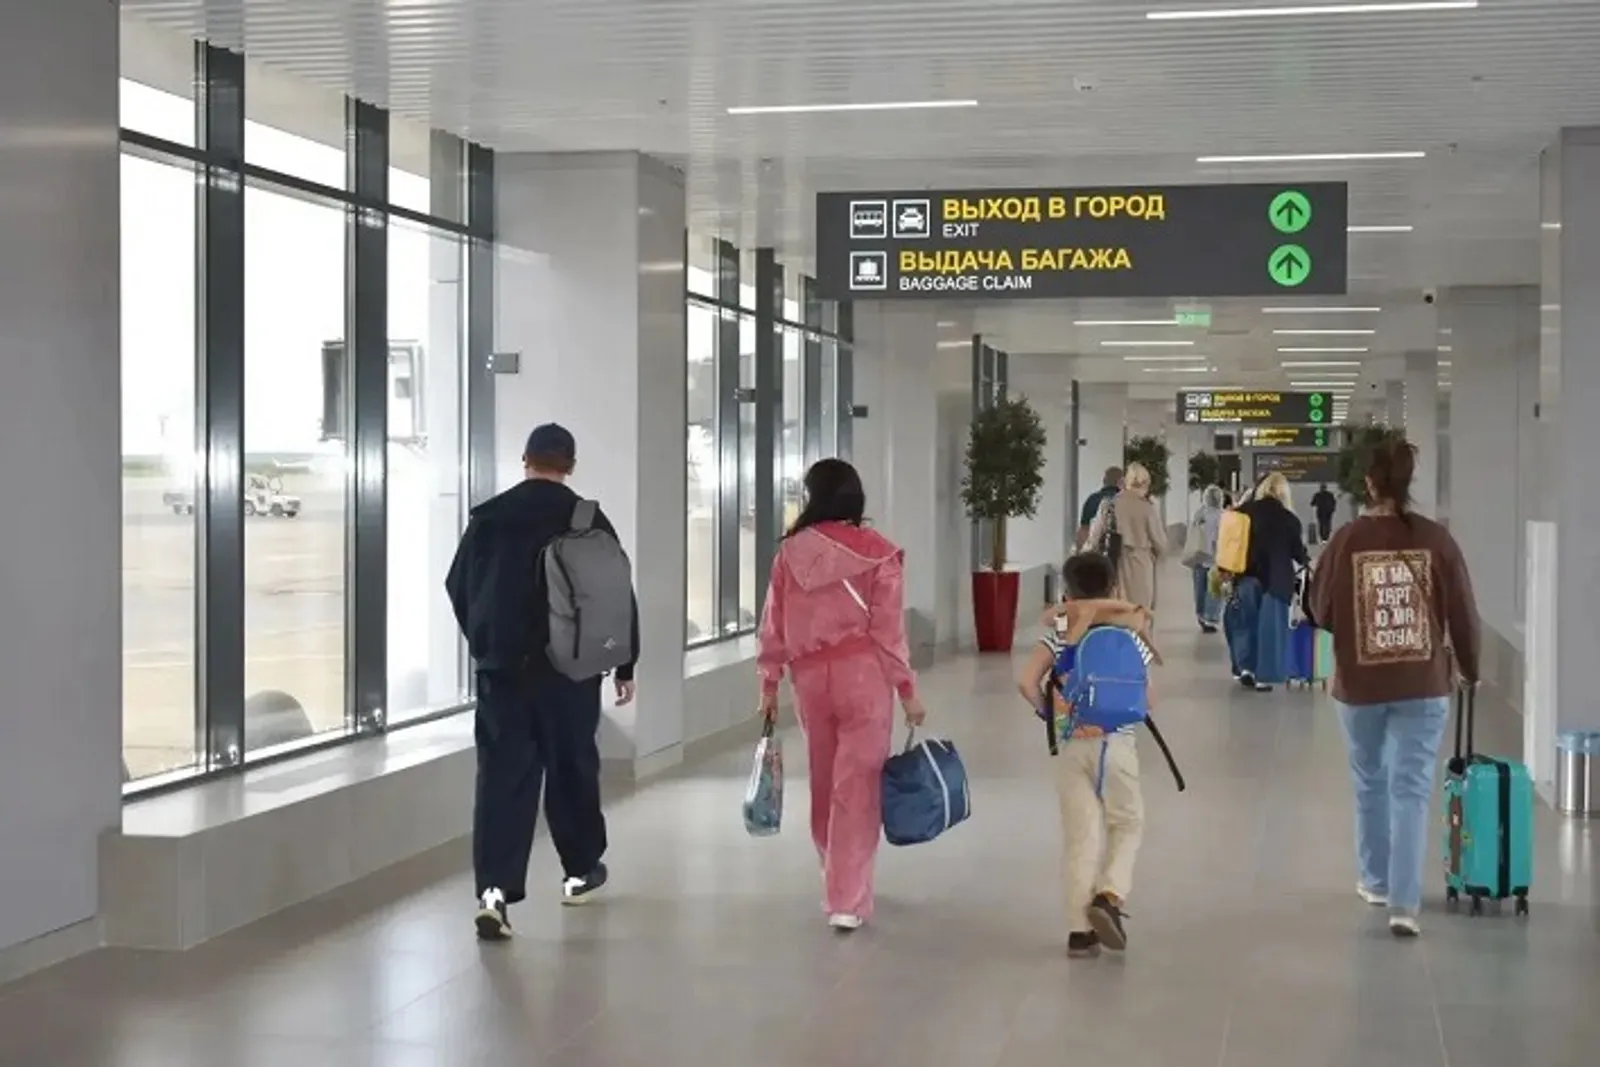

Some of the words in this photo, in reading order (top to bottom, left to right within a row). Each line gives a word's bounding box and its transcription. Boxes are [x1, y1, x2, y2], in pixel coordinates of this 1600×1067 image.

[943, 197, 1040, 222] ВЫХОД
[1049, 197, 1066, 219] В
[1075, 195, 1165, 220] ГОРОД
[943, 223, 980, 237] EXIT
[900, 250, 1014, 274] ВЫДАЧА
[1021, 248, 1132, 270] БАГАЖА
[900, 276, 978, 291] BAGGAGE
[983, 275, 1032, 290] CLAIM
